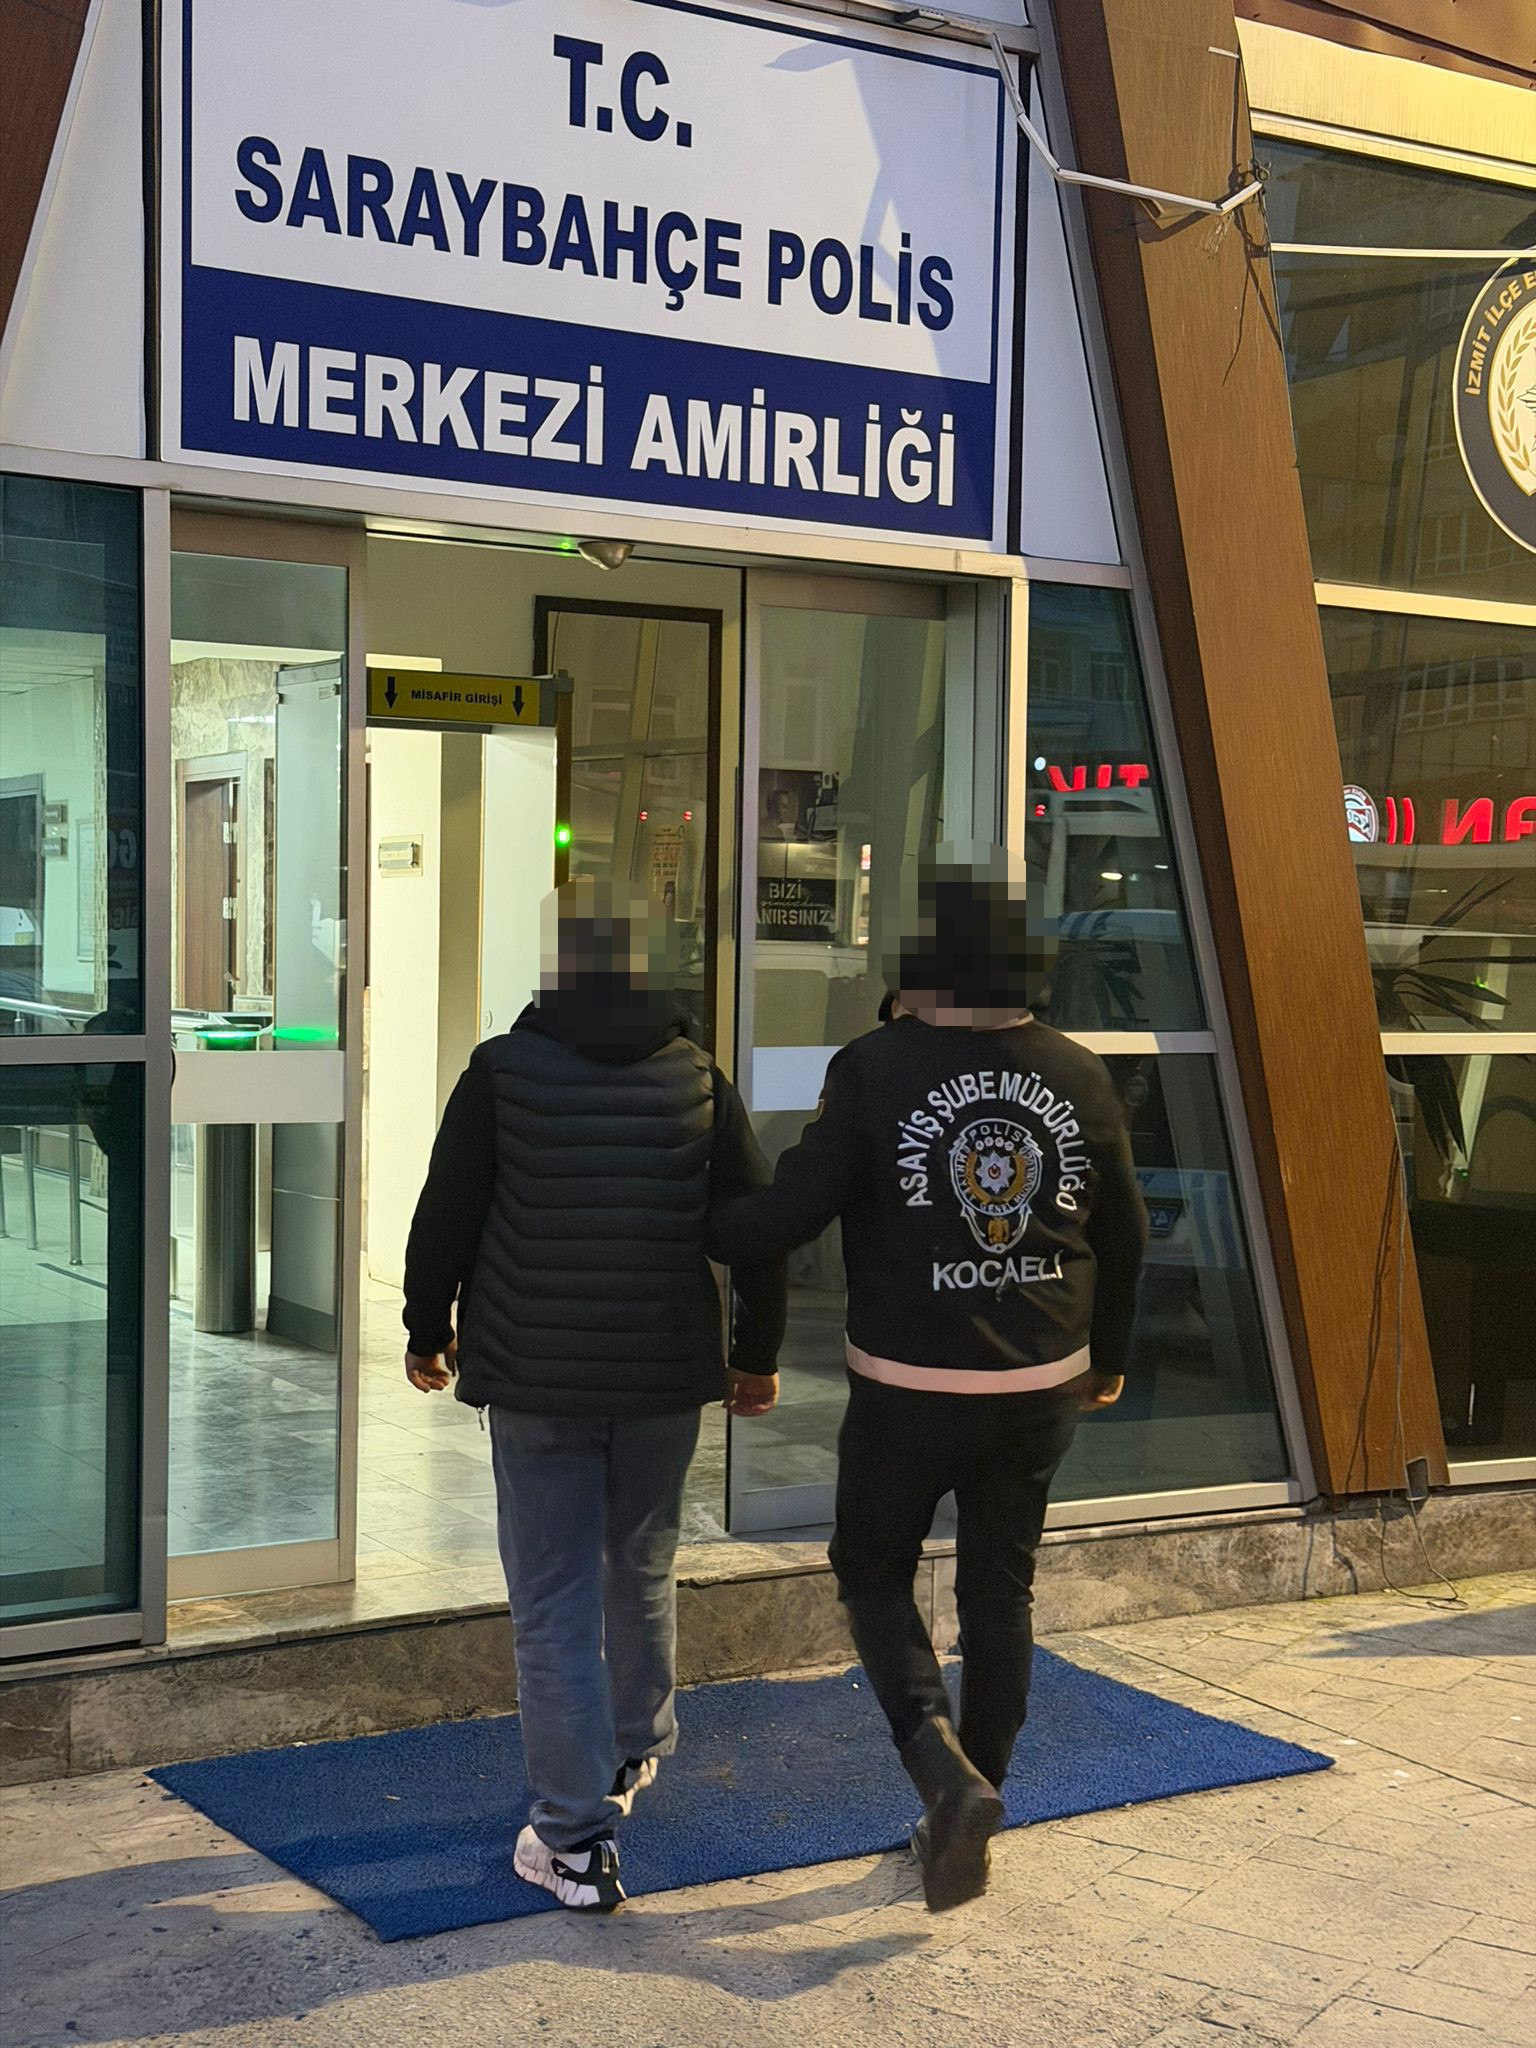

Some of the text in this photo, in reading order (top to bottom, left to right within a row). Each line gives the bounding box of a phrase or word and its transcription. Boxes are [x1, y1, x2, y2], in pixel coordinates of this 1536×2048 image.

[553, 34, 692, 148] T.C.
[235, 136, 954, 331] SARAYBAHÇE POLİS
[1484, 280, 1522, 326] İLÇE
[232, 335, 955, 508] MERKEZİ AMİRLİĞİ
[411, 688, 461, 702] MİSAFİR
[897, 1109, 944, 1206] ASAYİŞ
[927, 1071, 997, 1123] ŞUBE
